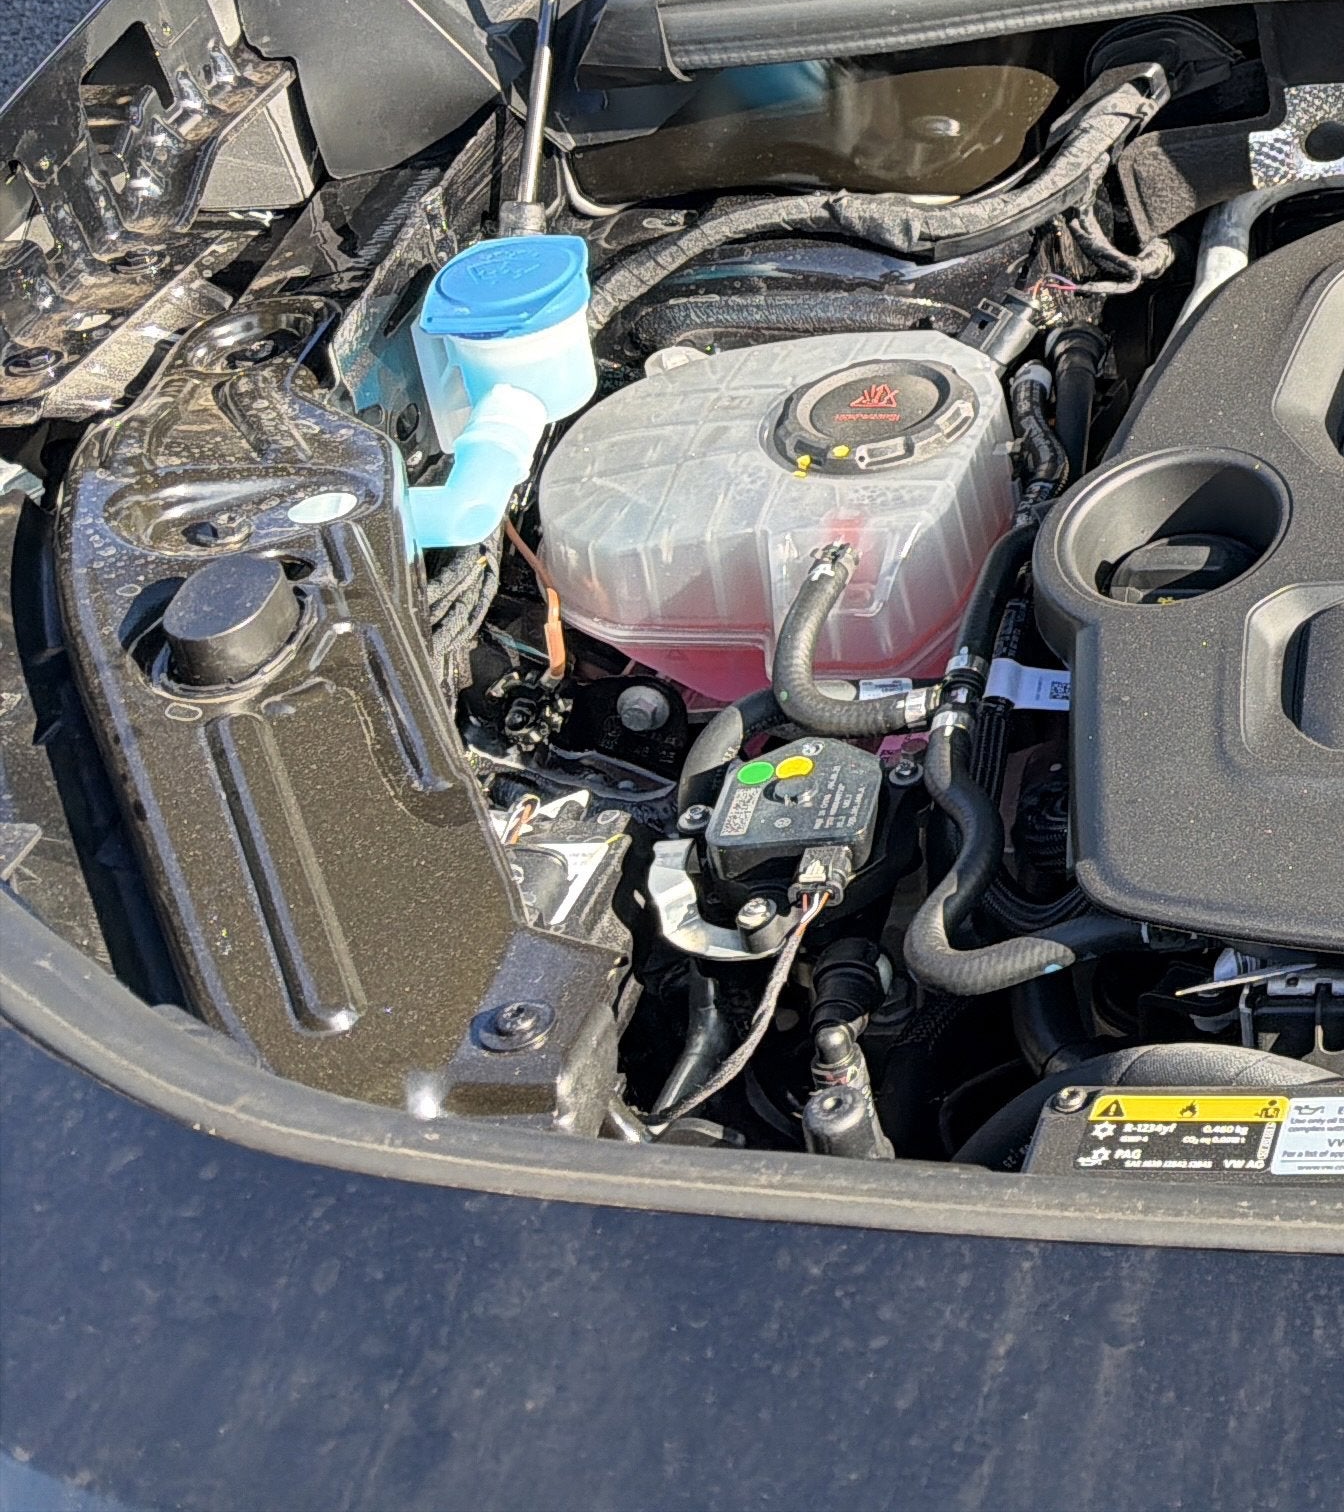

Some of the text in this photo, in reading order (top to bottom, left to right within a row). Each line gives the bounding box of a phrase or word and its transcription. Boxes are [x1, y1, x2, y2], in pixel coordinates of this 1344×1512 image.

[1123, 1123, 1177, 1136] R-1234yf
[1235, 1125, 1249, 1136] kg
[1114, 1149, 1142, 1160] PAG
[1224, 1160, 1246, 1168] VW
[1247, 1160, 1266, 1169] AG
